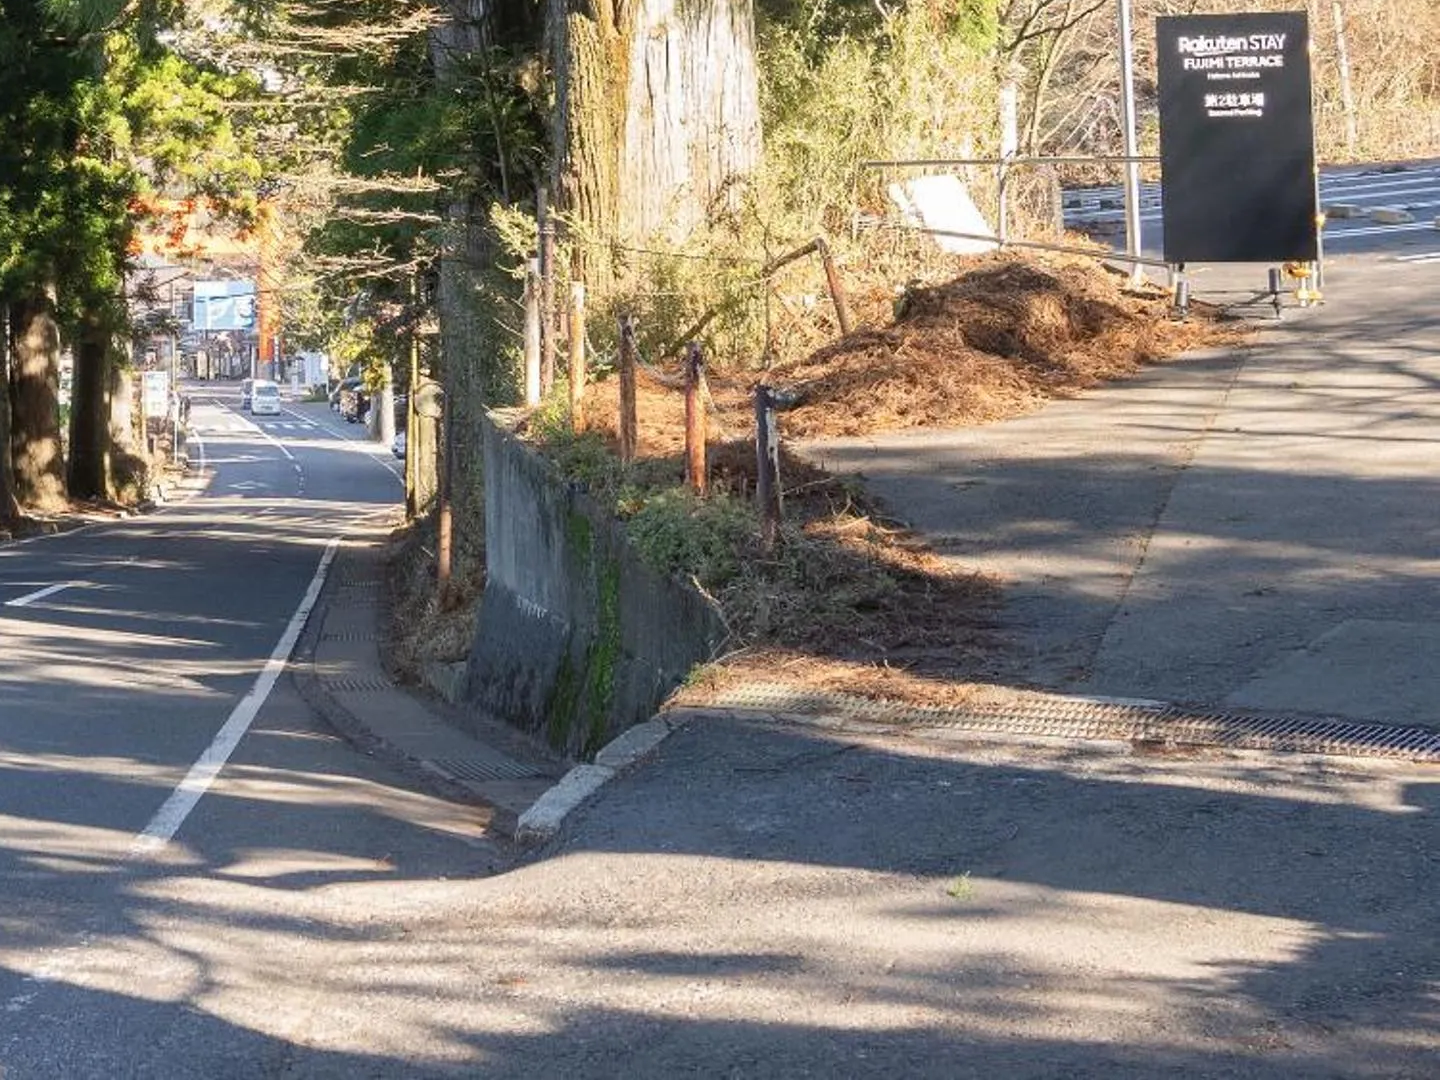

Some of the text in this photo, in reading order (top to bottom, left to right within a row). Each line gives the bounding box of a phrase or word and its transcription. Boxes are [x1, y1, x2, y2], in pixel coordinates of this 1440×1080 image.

[1177, 33, 1287, 54] Rakuten STAY
[1184, 55, 1284, 70] FUJIMI TERRACE
